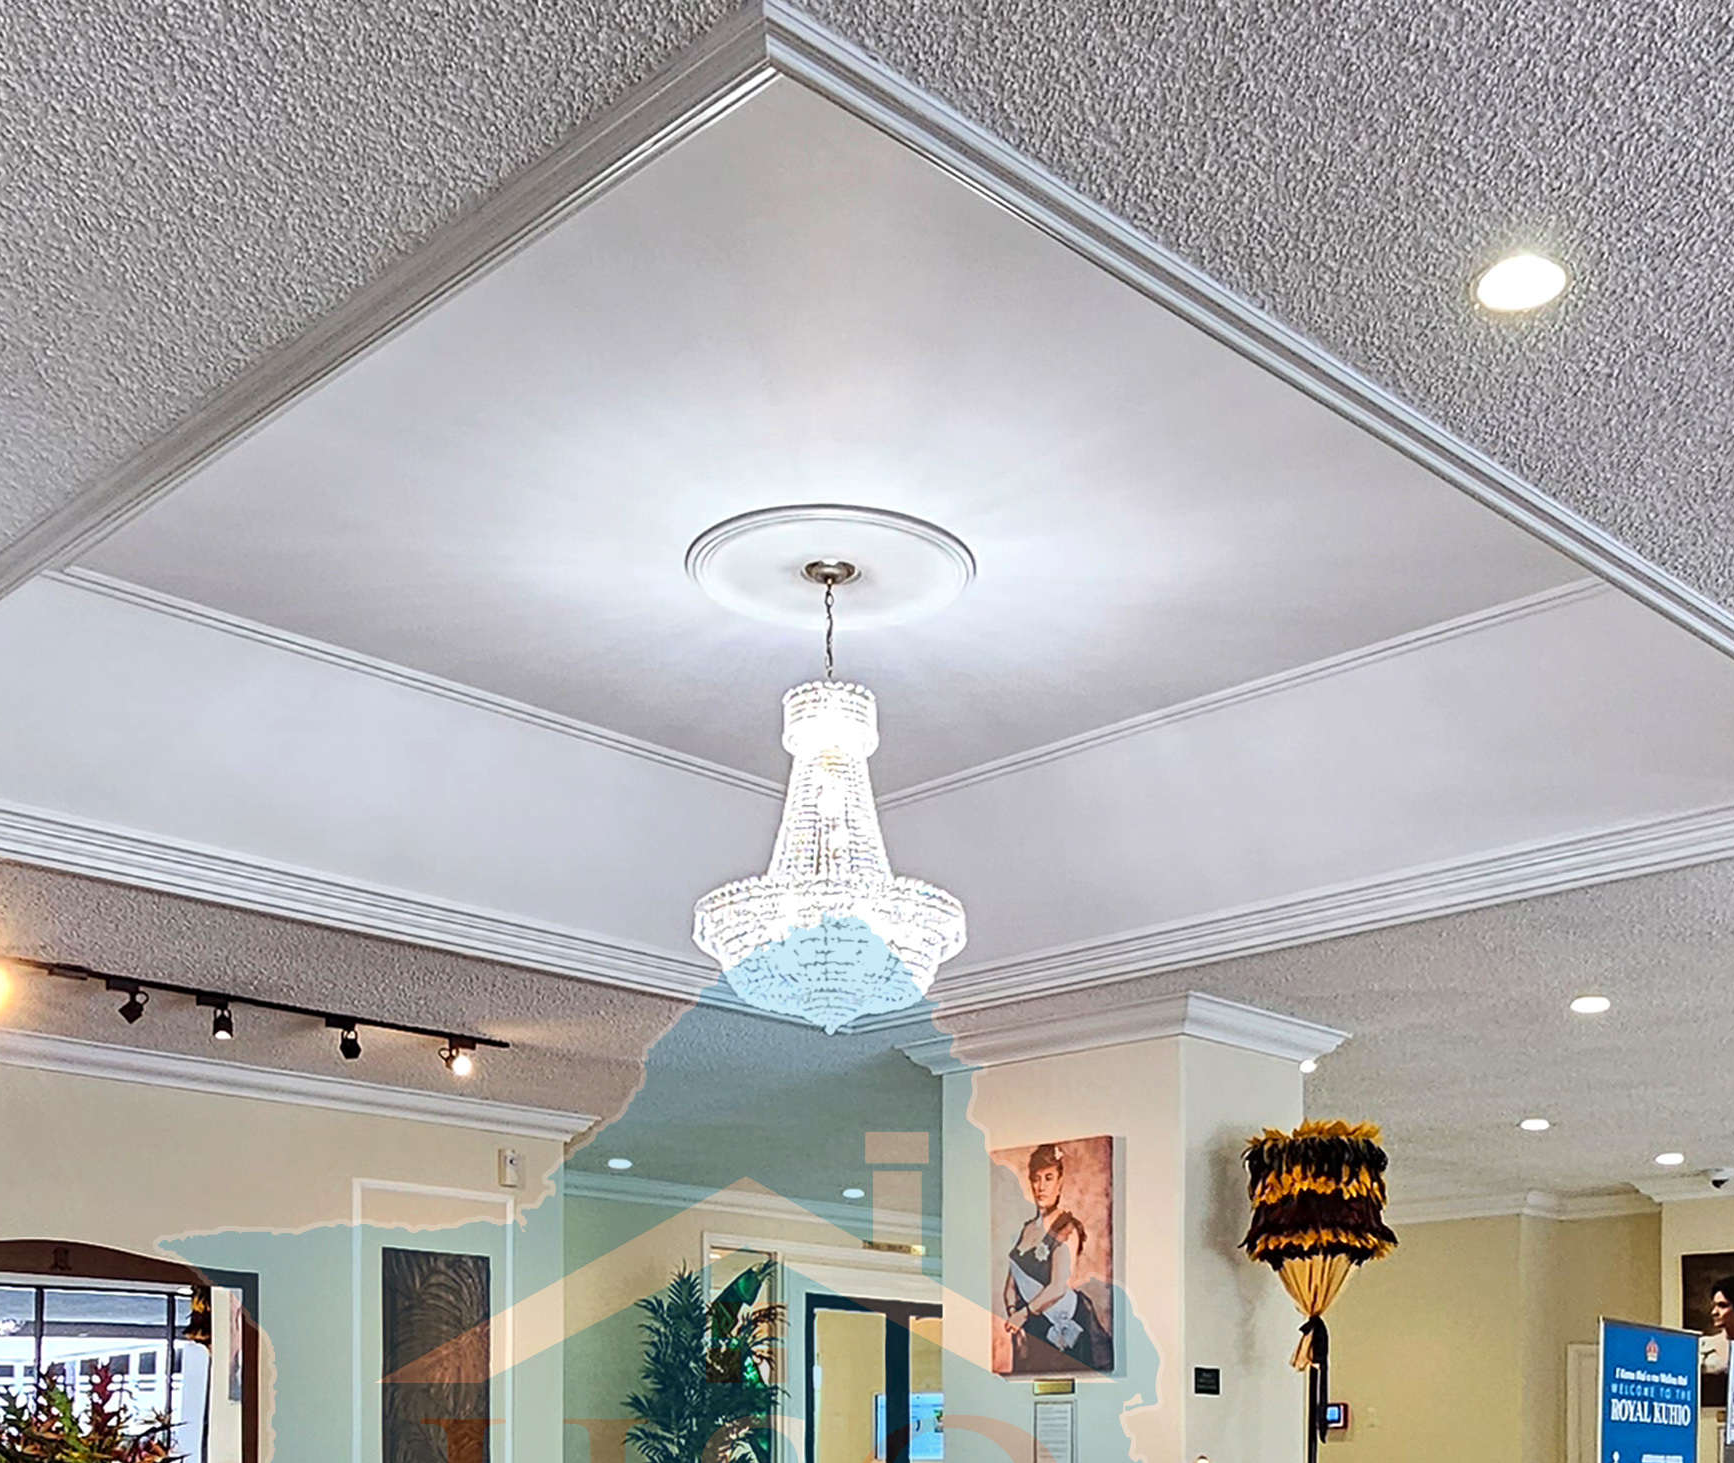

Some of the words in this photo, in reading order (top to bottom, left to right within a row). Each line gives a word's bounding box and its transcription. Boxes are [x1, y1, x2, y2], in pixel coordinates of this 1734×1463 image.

[1610, 1383, 1655, 1398] WELCOME
[1660, 1386, 1672, 1400] TO
[1676, 1388, 1692, 1402] THE
[1610, 1398, 1652, 1423] ROYAL
[1653, 1401, 1692, 1427] KUHIO
